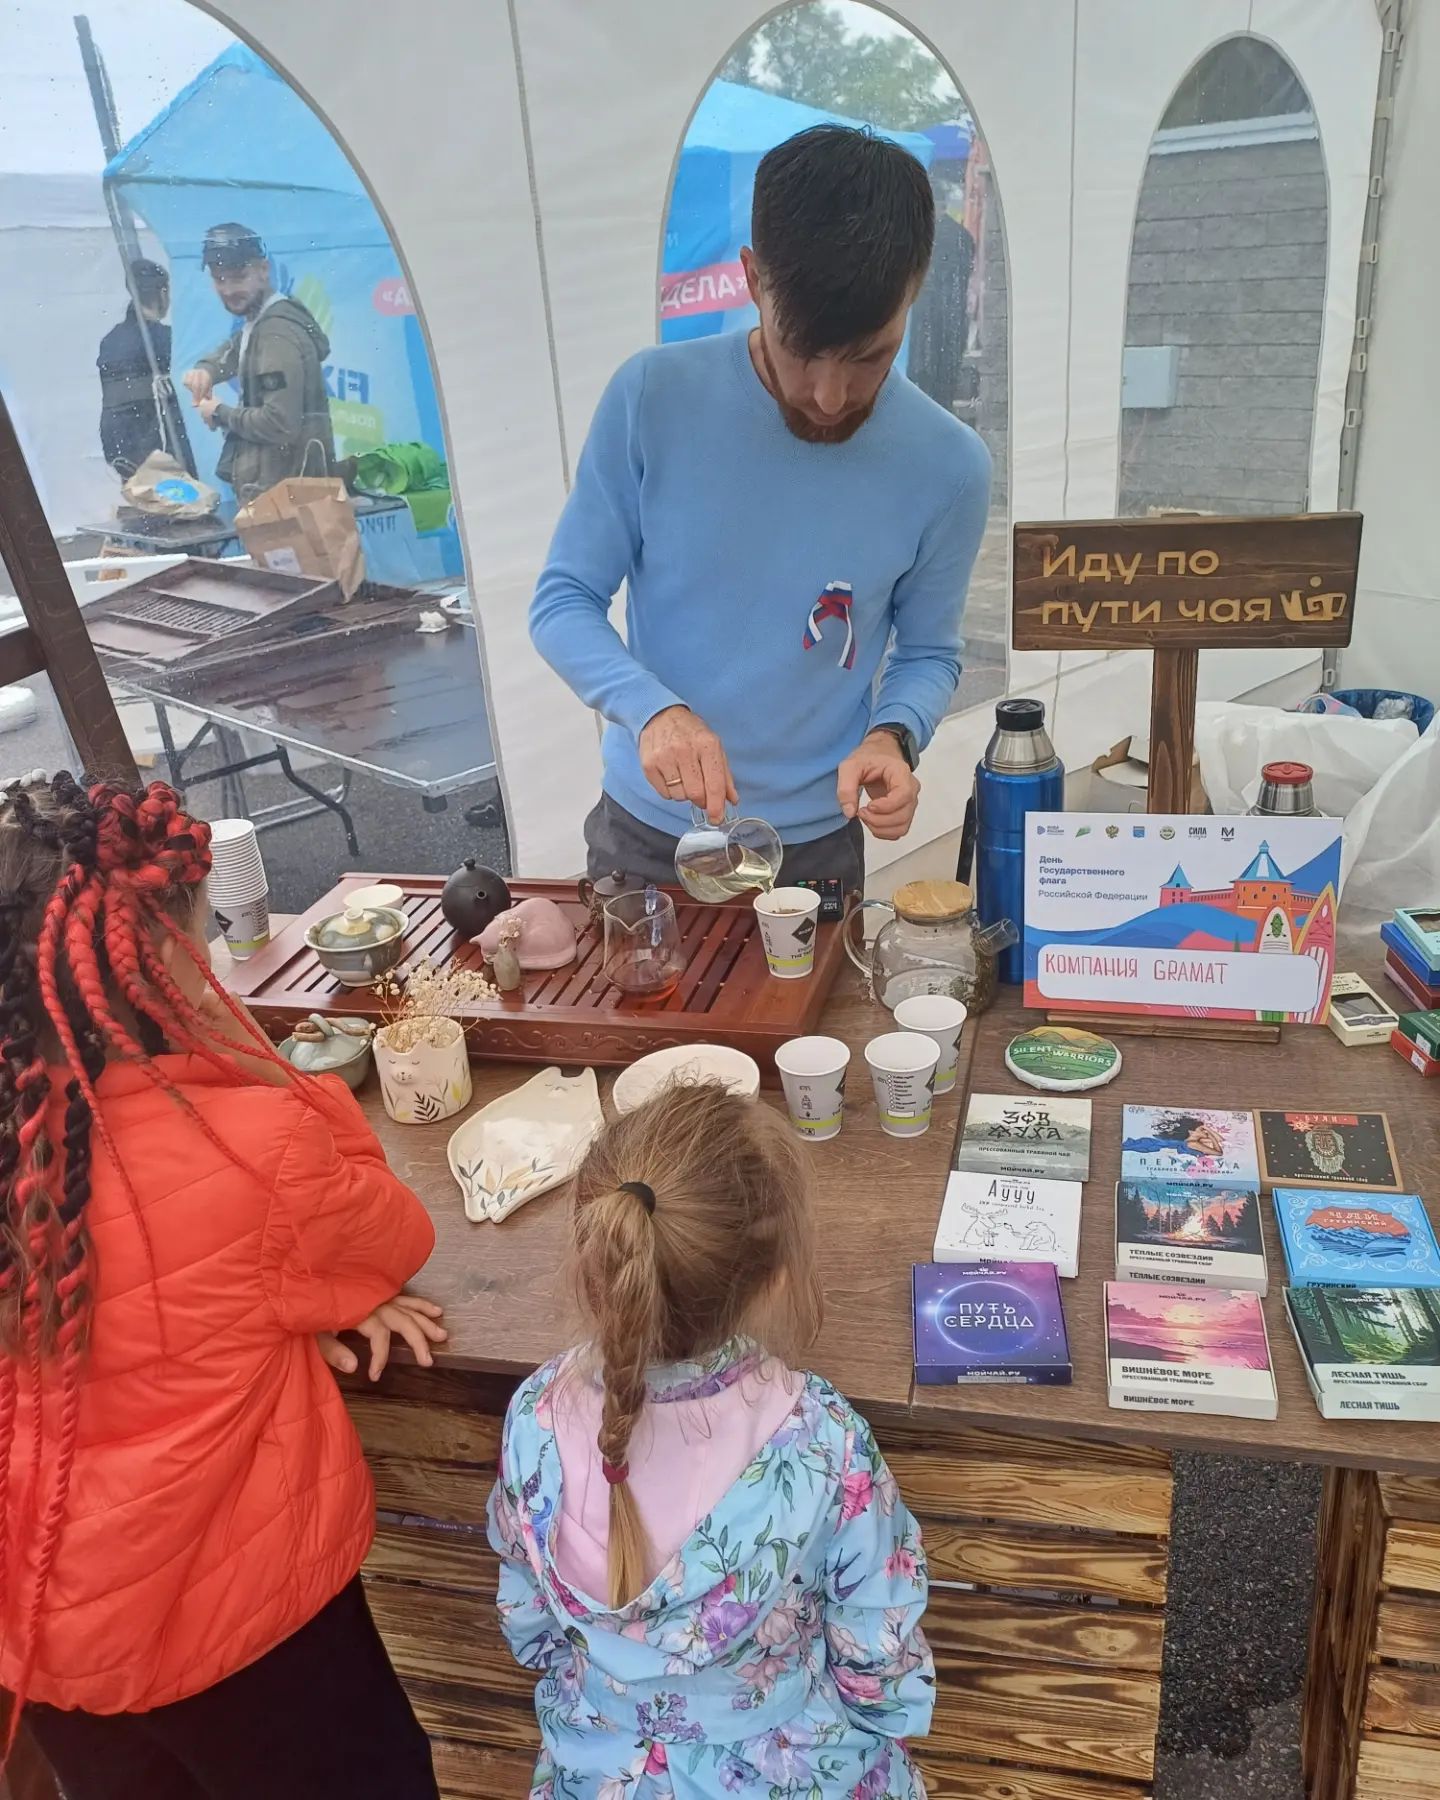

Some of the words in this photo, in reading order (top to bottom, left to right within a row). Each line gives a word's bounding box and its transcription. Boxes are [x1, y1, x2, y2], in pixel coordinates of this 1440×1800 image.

[1042, 545, 1143, 585] Иду
[1157, 549, 1220, 576] по
[1041, 600, 1162, 633] пути
[1178, 597, 1272, 623] чая
[1039, 855, 1063, 864] День
[1039, 866, 1125, 877] Государственного
[1038, 876, 1067, 885] флага
[1038, 889, 1093, 899] Российской
[1094, 891, 1148, 901] Федерации
[1045, 953, 1138, 978] КОМПАНИЯ
[1153, 959, 1229, 985] GRAMAT
[1013, 1045, 1052, 1055] SILENT
[1051, 1049, 1112, 1067] WARRIORS
[1323, 1218, 1387, 1226] ГРУЗИНСКИЙ
[1165, 1252, 1214, 1261] СОЗВЕЗДИЯ
[1161, 1275, 1206, 1284] СОЗВЕЗДИЯ
[959, 1303, 1016, 1314] ПУТЬ
[944, 1315, 1034, 1330] СЕРДЦА
[1121, 1365, 1180, 1376] ВИШНЁВОЕ
[1182, 1370, 1212, 1379] МОРЕ
[1123, 1395, 1170, 1404] ВИШНЁВОЕ
[1171, 1398, 1195, 1406] МОРЕ
[1340, 1401, 1373, 1409] ЛЕСНАЯ
[1374, 1402, 1400, 1410] ТИШЬ
